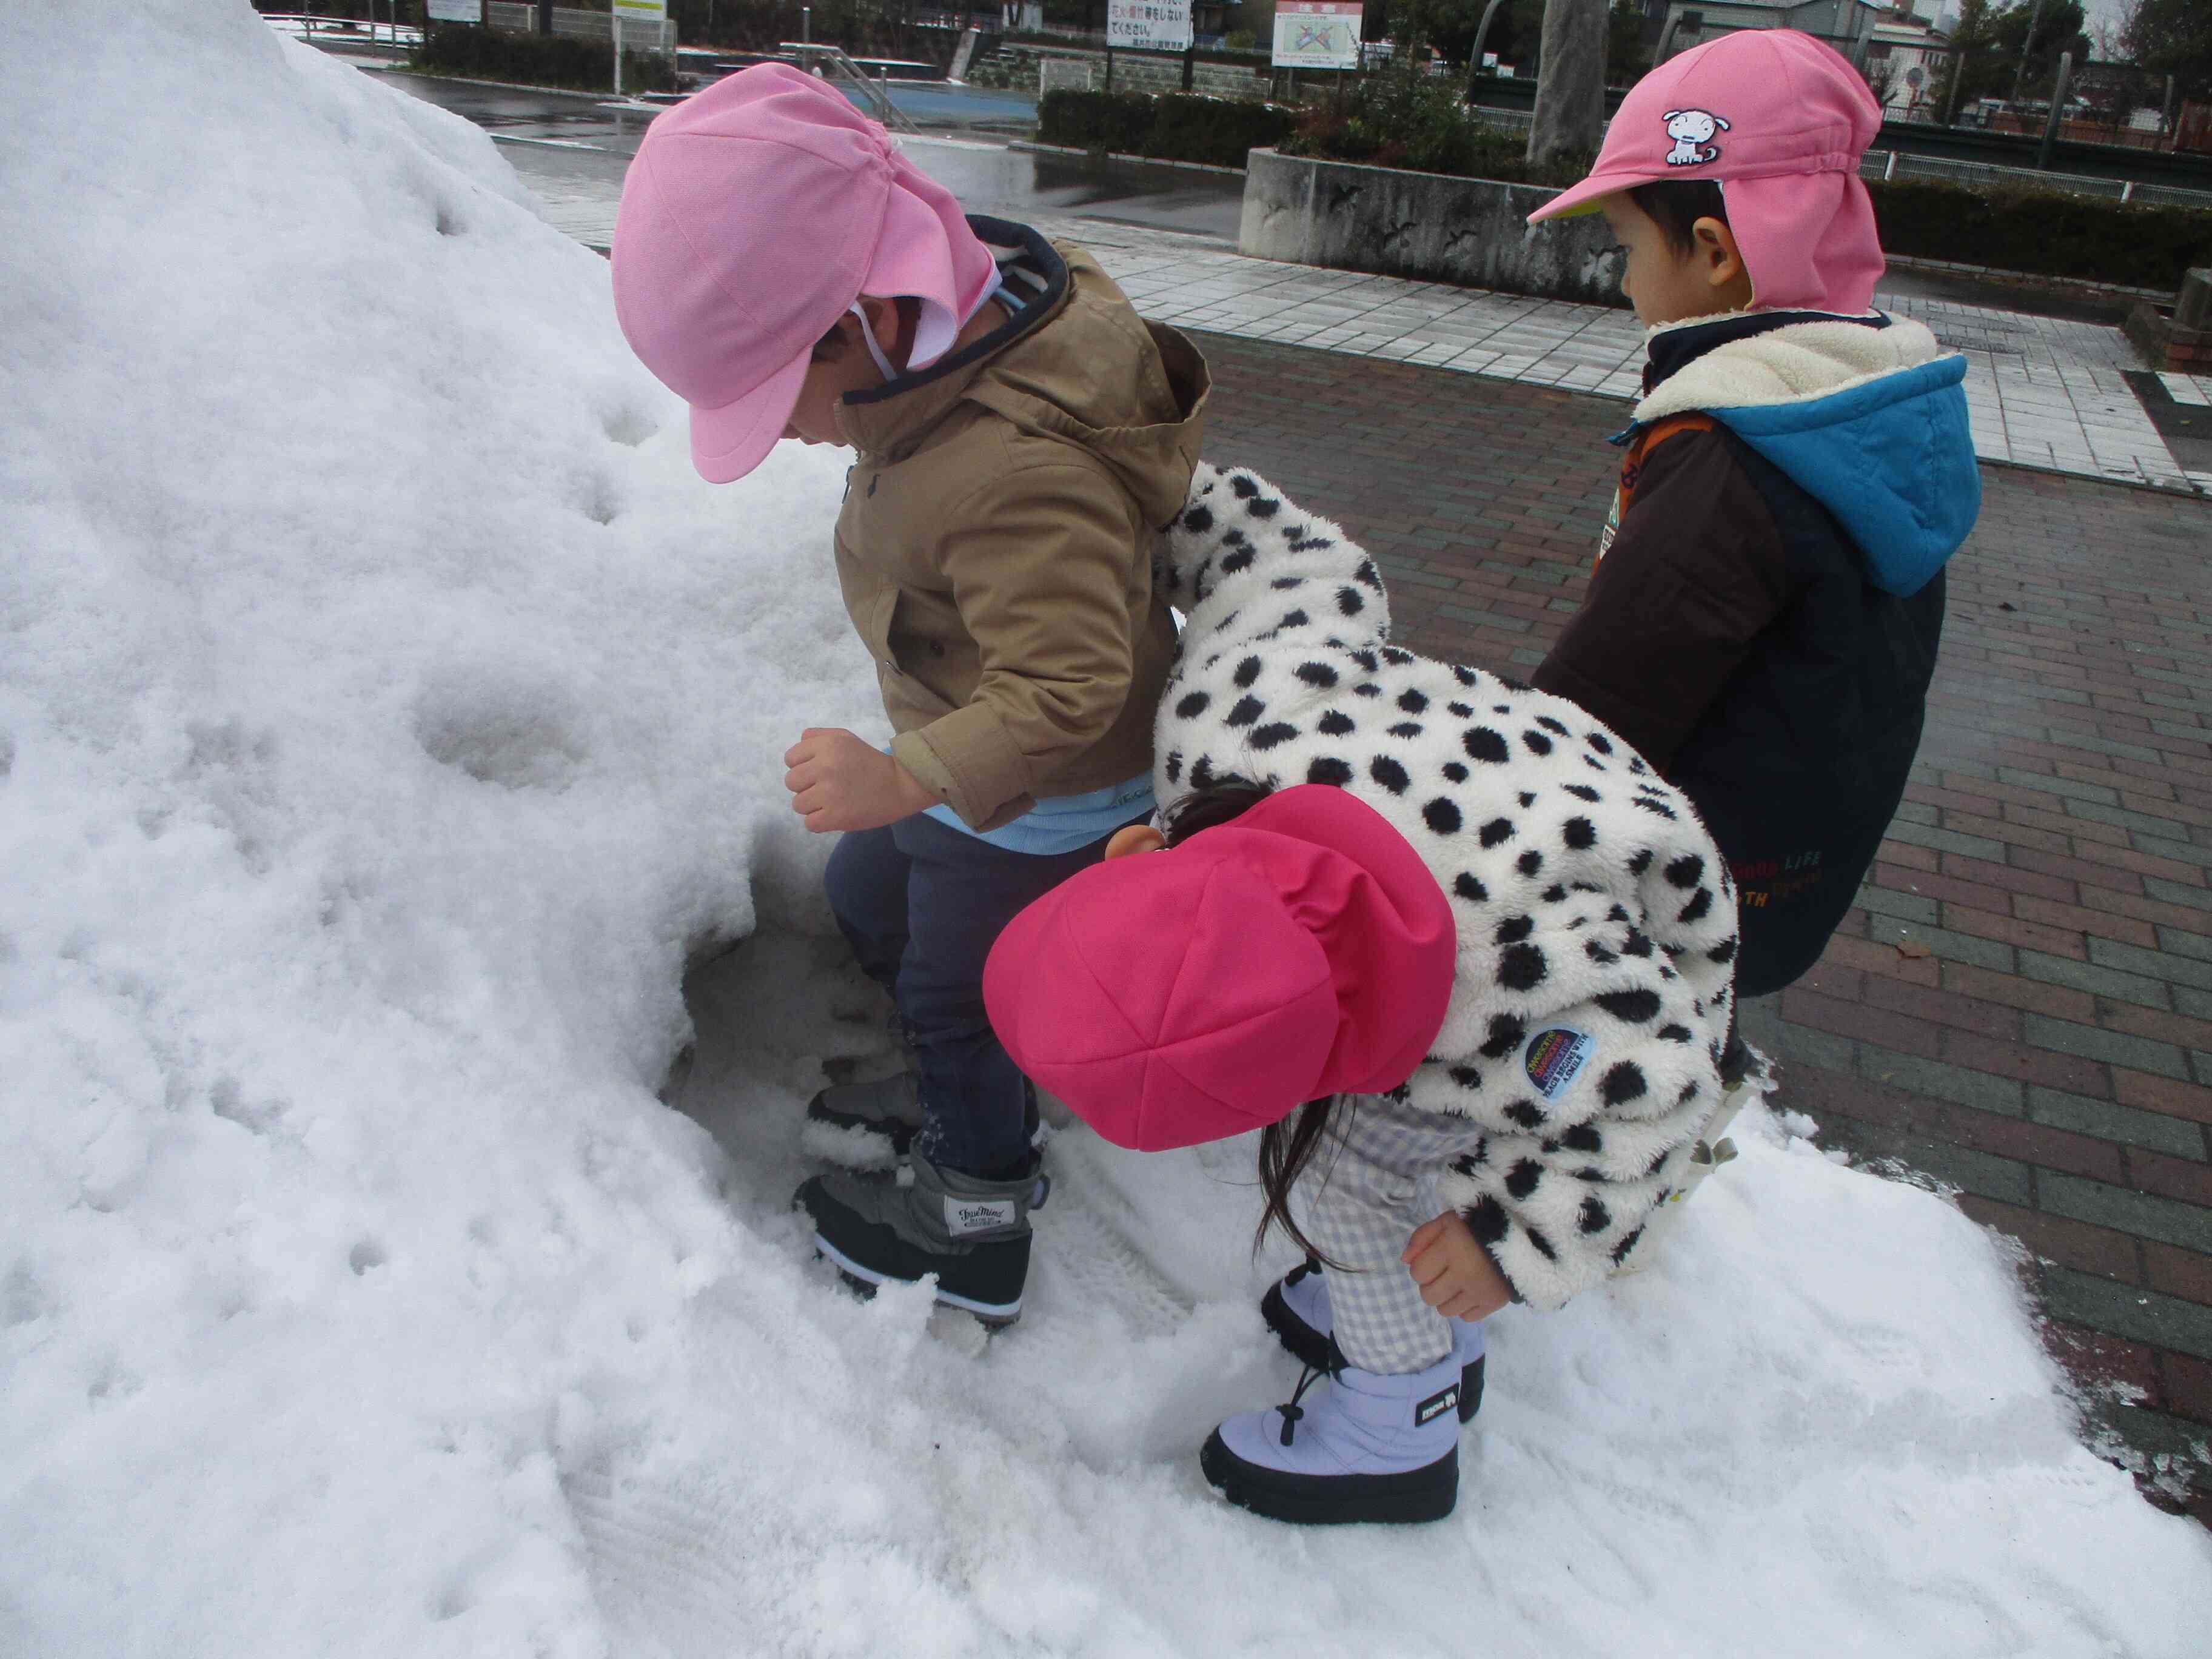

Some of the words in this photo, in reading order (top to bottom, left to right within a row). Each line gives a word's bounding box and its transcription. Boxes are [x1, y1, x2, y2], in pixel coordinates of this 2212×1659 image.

[1111, 21, 1150, 37] てください。
[1556, 1051, 1577, 1076] BEGINS
[1572, 1033, 1589, 1051] WITH
[1565, 1054, 1584, 1077] SMILE
